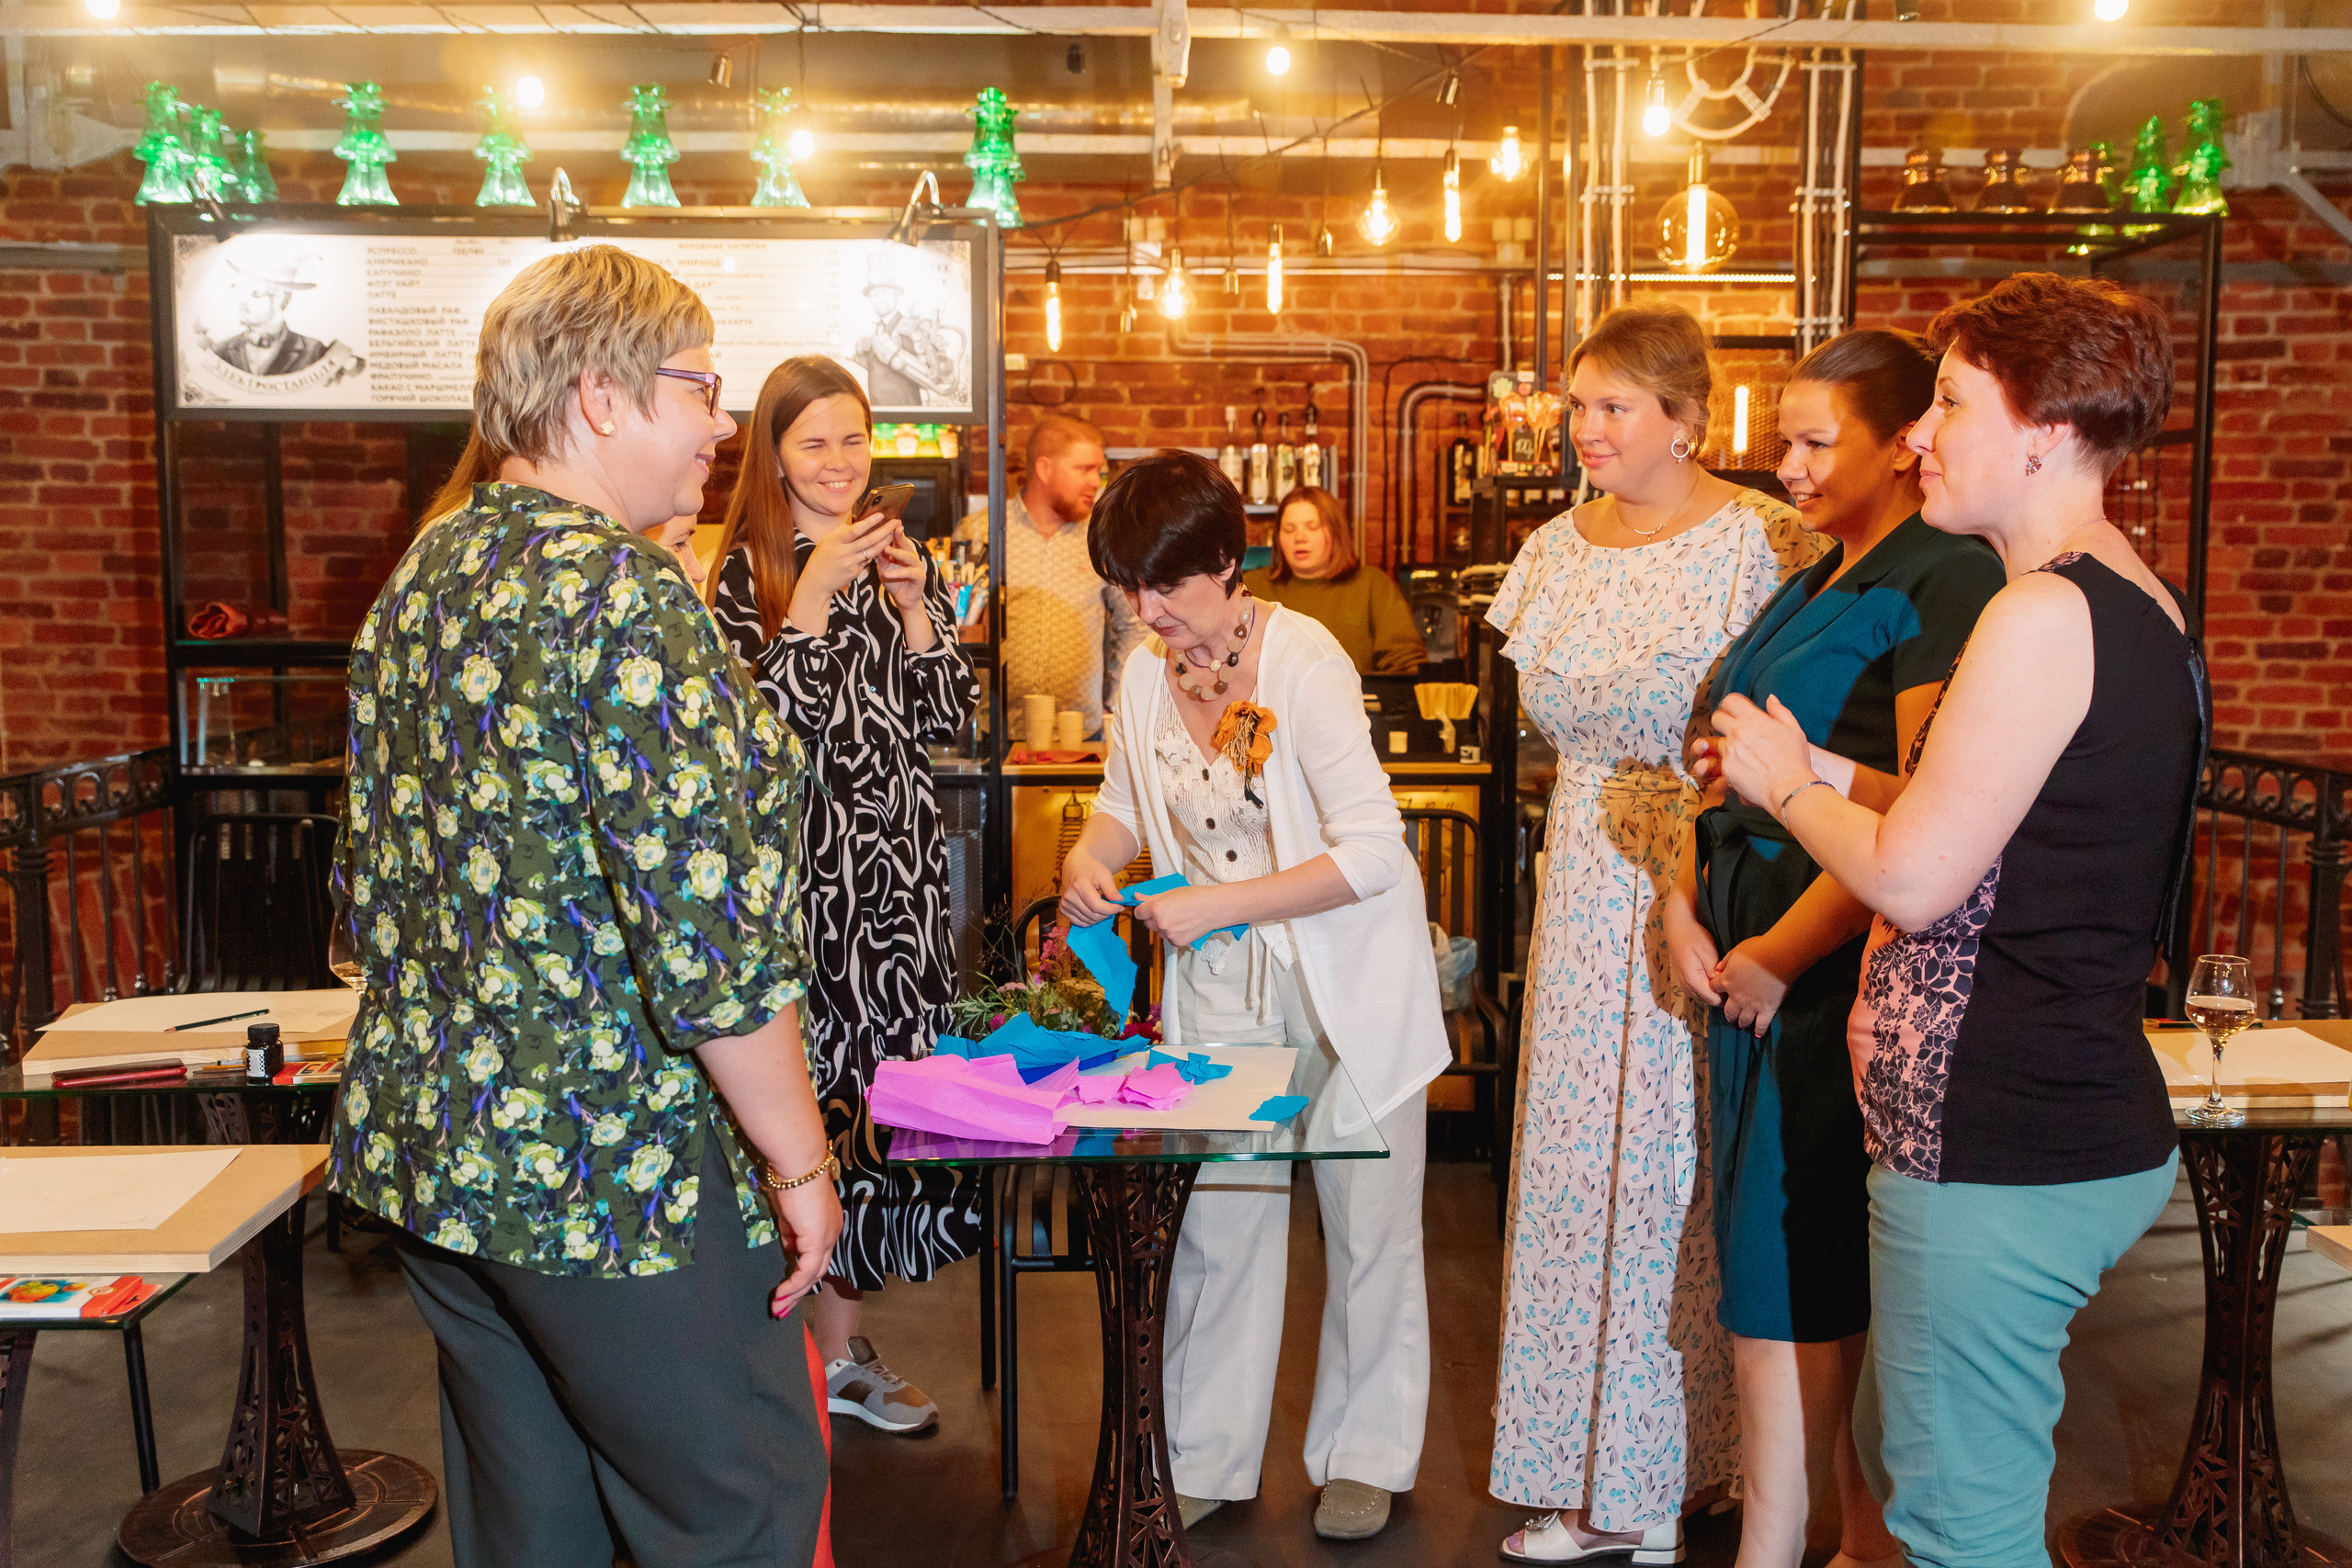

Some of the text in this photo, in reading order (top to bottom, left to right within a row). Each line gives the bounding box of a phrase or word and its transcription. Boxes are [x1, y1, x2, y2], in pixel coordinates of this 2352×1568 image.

[368, 247, 417, 255] ЭСПРЕССО
[368, 257, 429, 265] АМЕРИКАНО
[368, 290, 396, 299] ЛАТТЕ
[368, 305, 437, 314] ЛАВАНДОВЫЙ
[368, 317, 446, 325] ФИСТАШКОВЫЙ
[426, 329, 456, 337] ЛАТТЕ
[369, 338, 440, 348] БЕЛЬГИЙСКИЙ
[433, 351, 463, 359] ЛАТТЕ
[370, 360, 420, 369] МЕДОВЫЙ
[370, 384, 404, 392] КАКАО
[371, 393, 416, 403] ГОРЯЧИЙ
